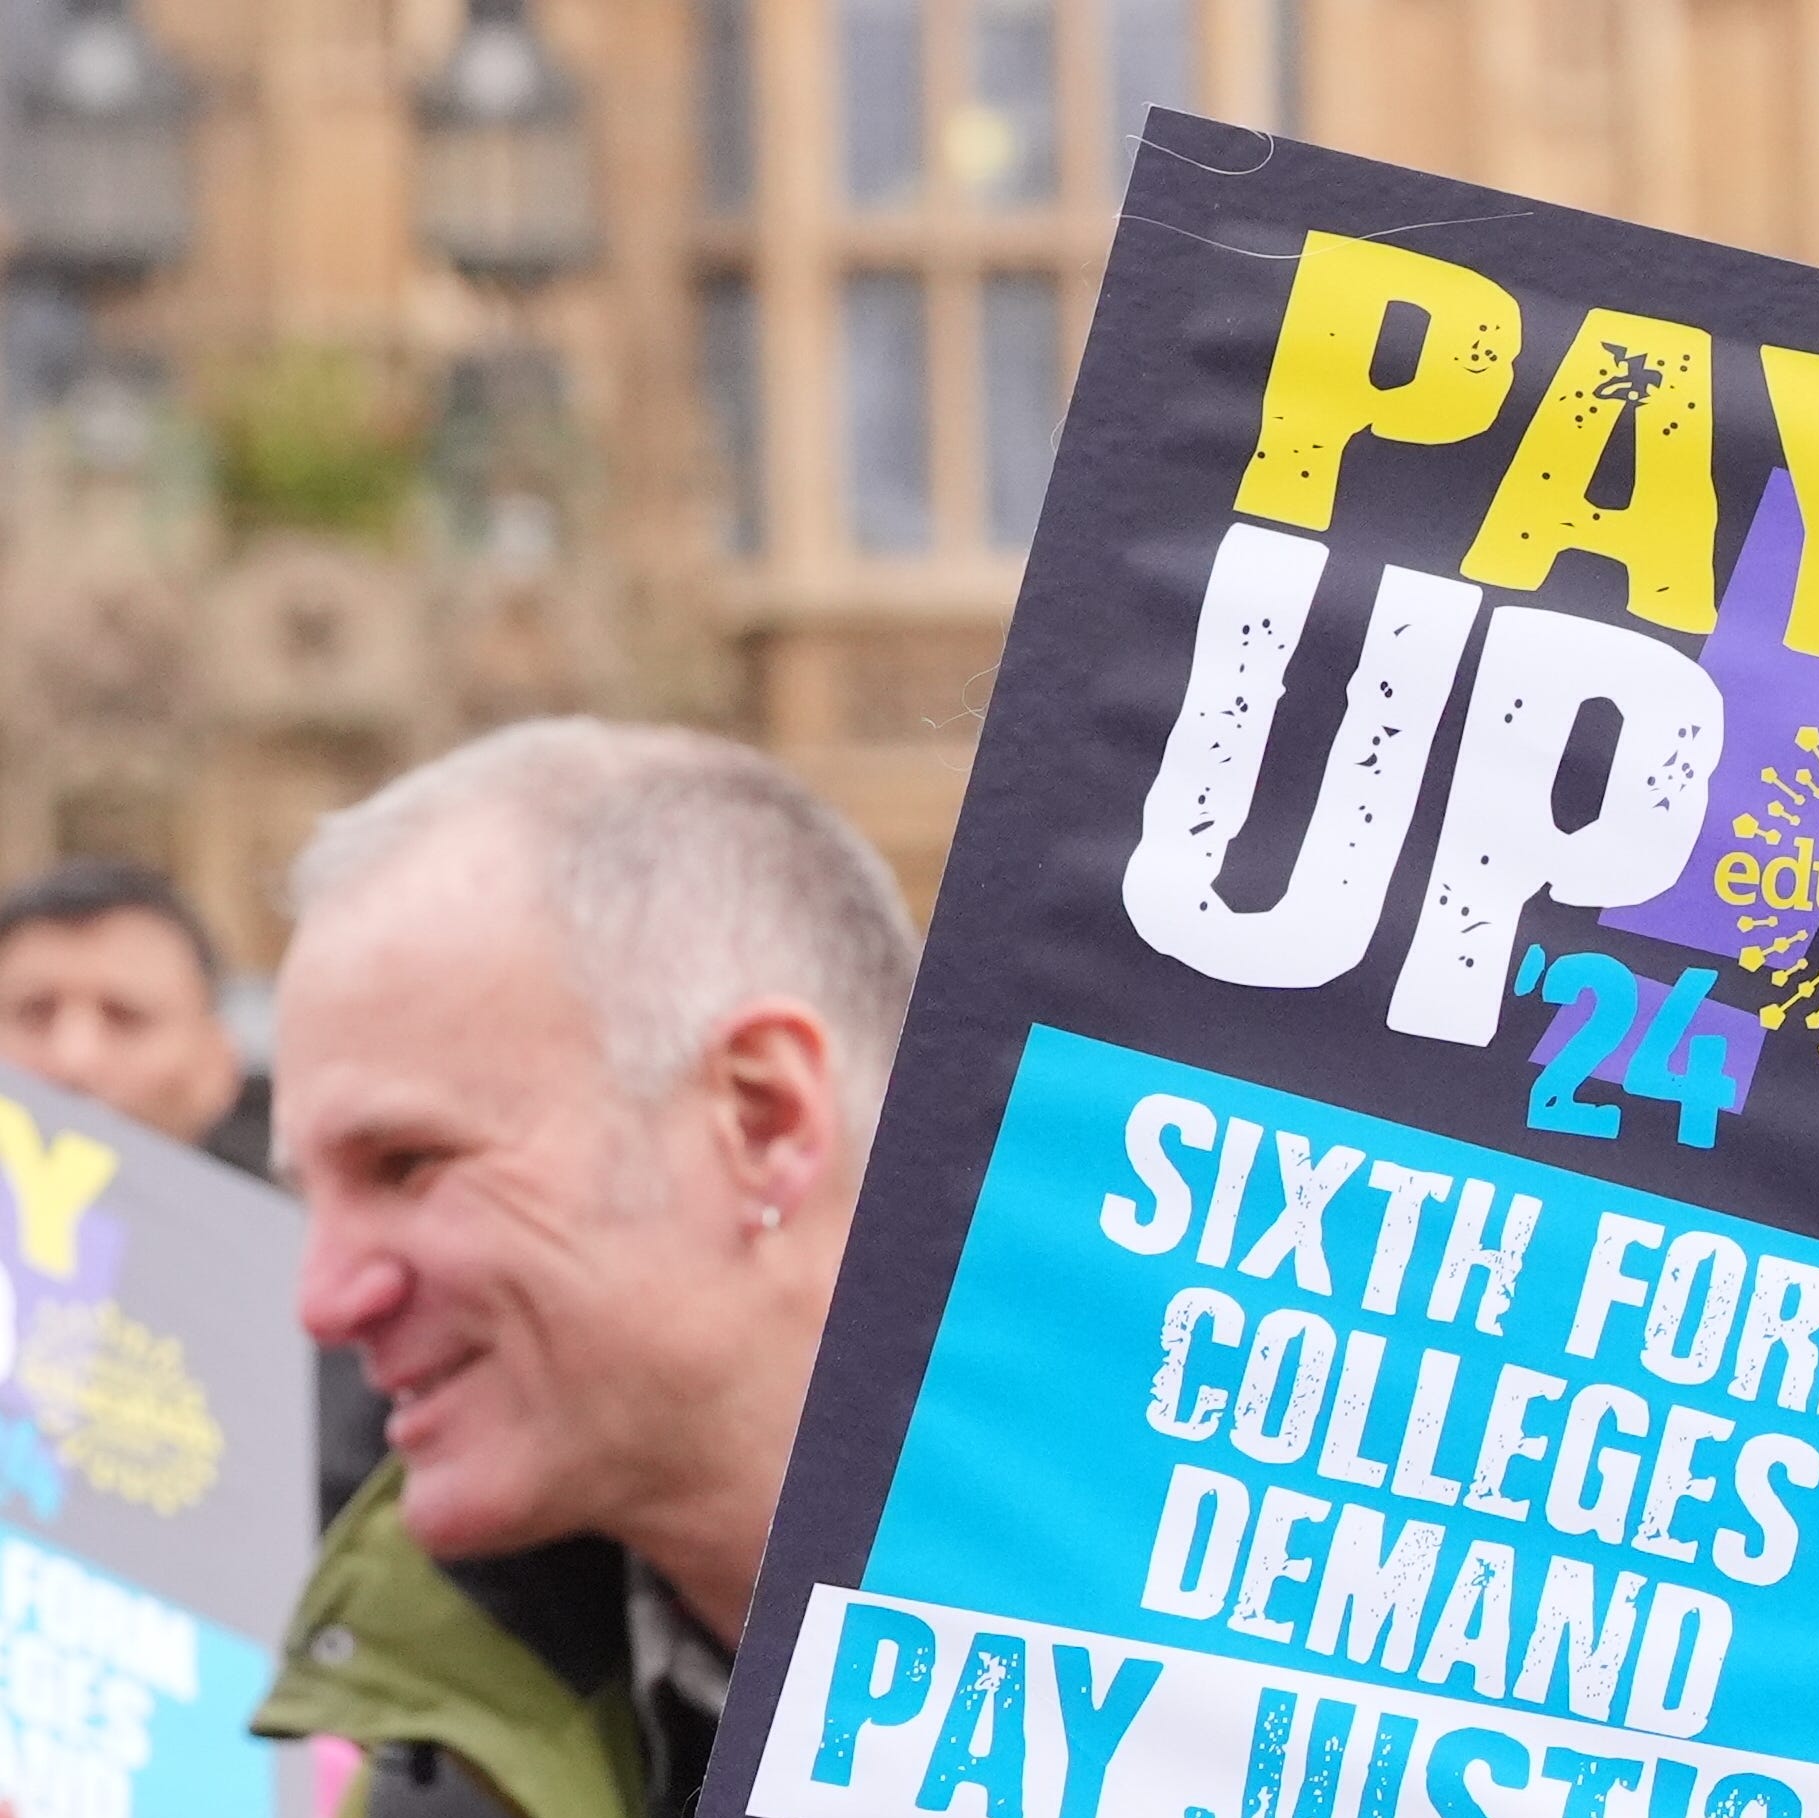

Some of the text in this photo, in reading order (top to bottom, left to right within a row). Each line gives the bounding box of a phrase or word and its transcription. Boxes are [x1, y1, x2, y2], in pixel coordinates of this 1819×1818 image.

[1122, 523, 1726, 1049] UP
[1100, 1093, 1542, 1336] SIXTH
[1142, 1464, 1734, 1739] DEMAND
